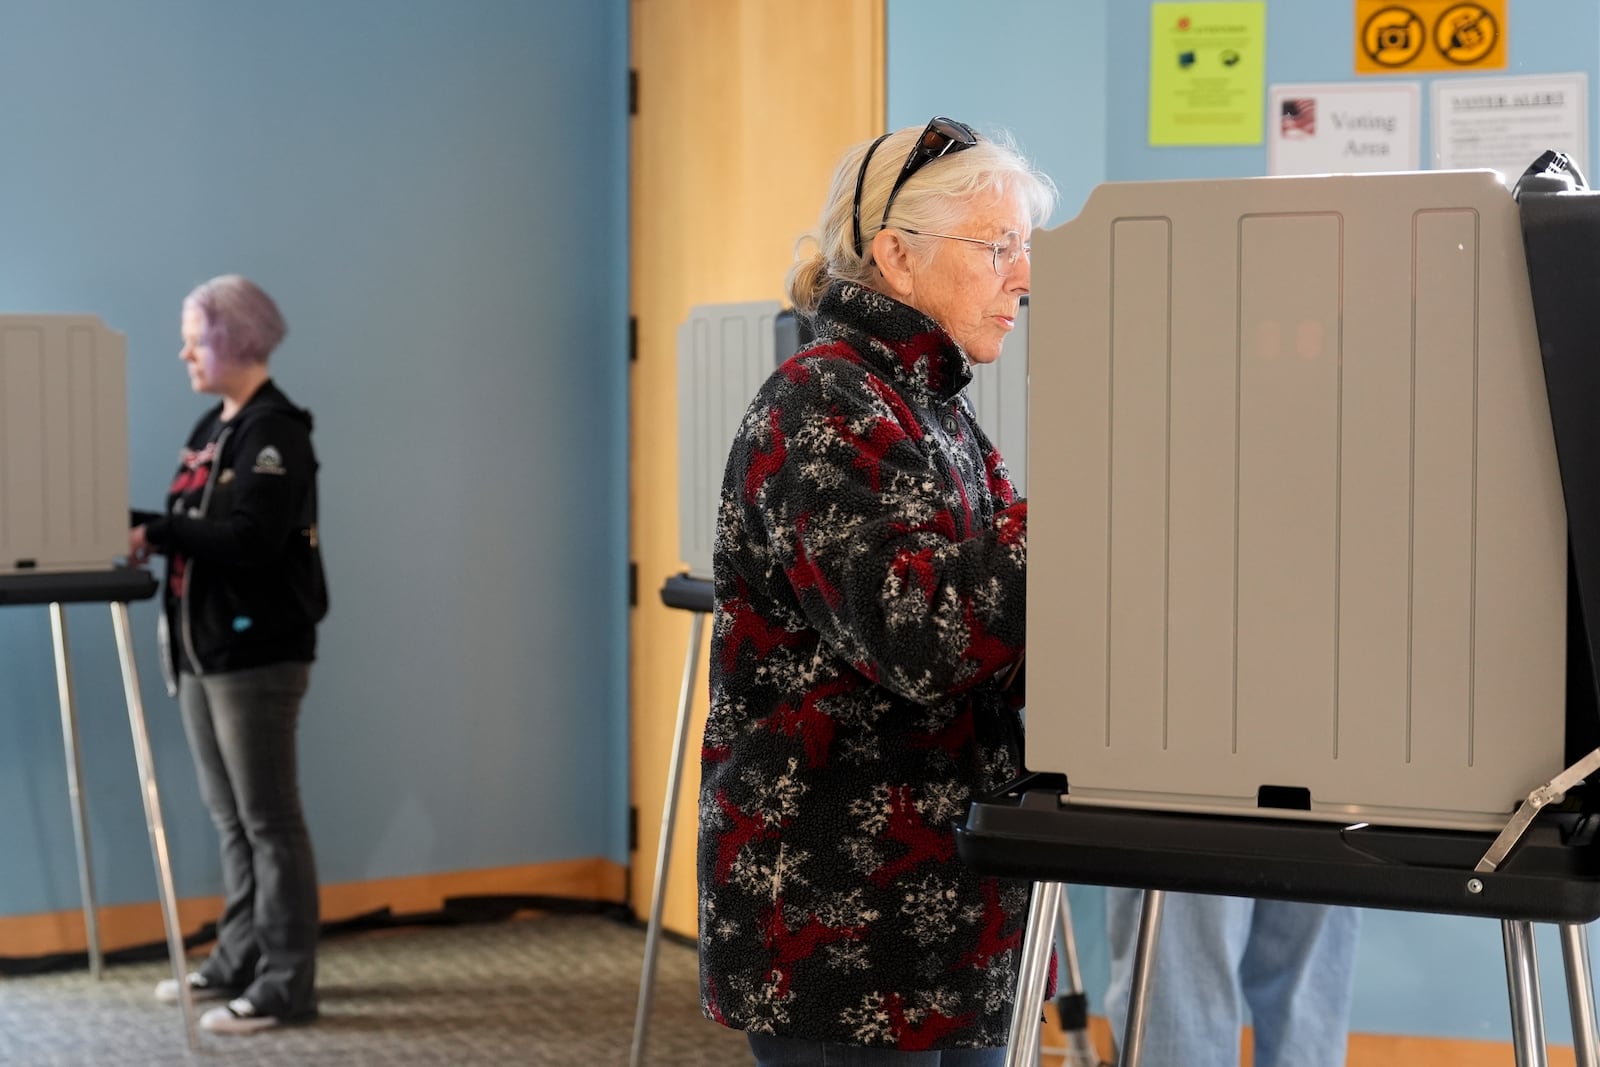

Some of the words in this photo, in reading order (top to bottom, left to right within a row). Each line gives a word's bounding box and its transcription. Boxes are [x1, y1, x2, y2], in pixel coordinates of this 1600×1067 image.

[1453, 95, 1507, 109] VOTER
[1513, 92, 1565, 107] ALERT
[1331, 112, 1396, 132] Voting
[1343, 140, 1390, 157] Area
